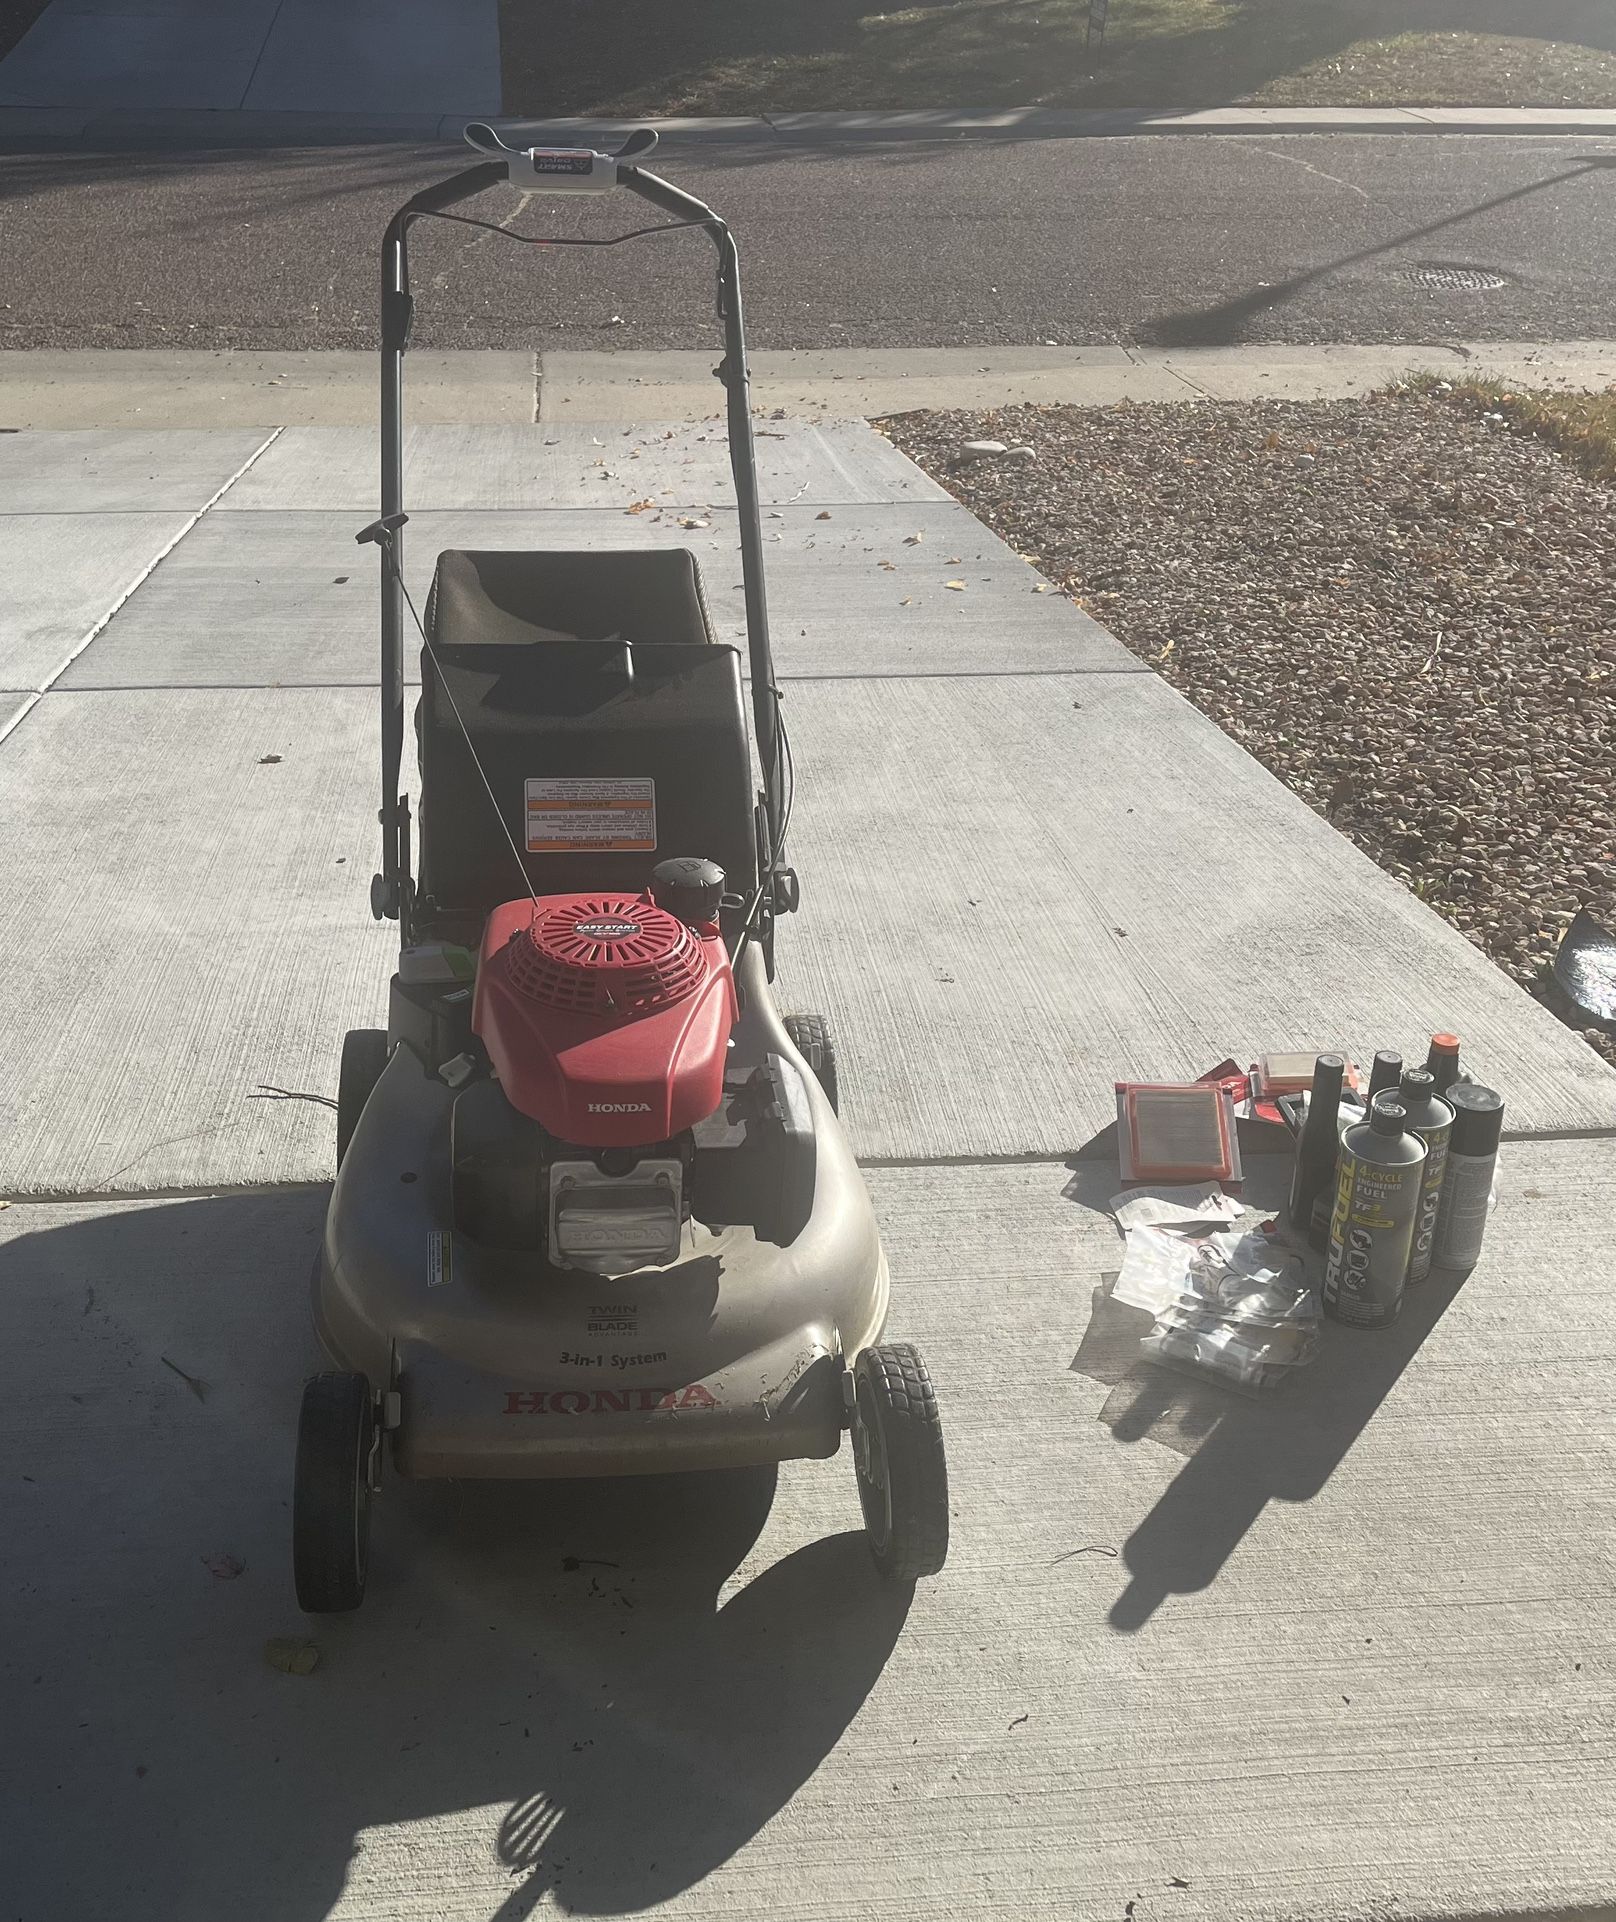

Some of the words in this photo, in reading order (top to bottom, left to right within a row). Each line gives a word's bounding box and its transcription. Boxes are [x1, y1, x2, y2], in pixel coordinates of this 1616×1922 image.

[588, 1103, 652, 1113] HONDA
[1360, 1165, 1403, 1183] 4-CYCLE
[1357, 1177, 1402, 1191] ENGINEERED
[1356, 1184, 1387, 1199] FUEL
[572, 1229, 665, 1241] HONDA
[1324, 1158, 1357, 1304] TRUFUEL
[588, 1305, 638, 1314] TWIN
[587, 1322, 638, 1331] BLADE
[559, 1351, 603, 1367] 3-in-1
[610, 1351, 667, 1369] System
[502, 1385, 722, 1414] HONDA
